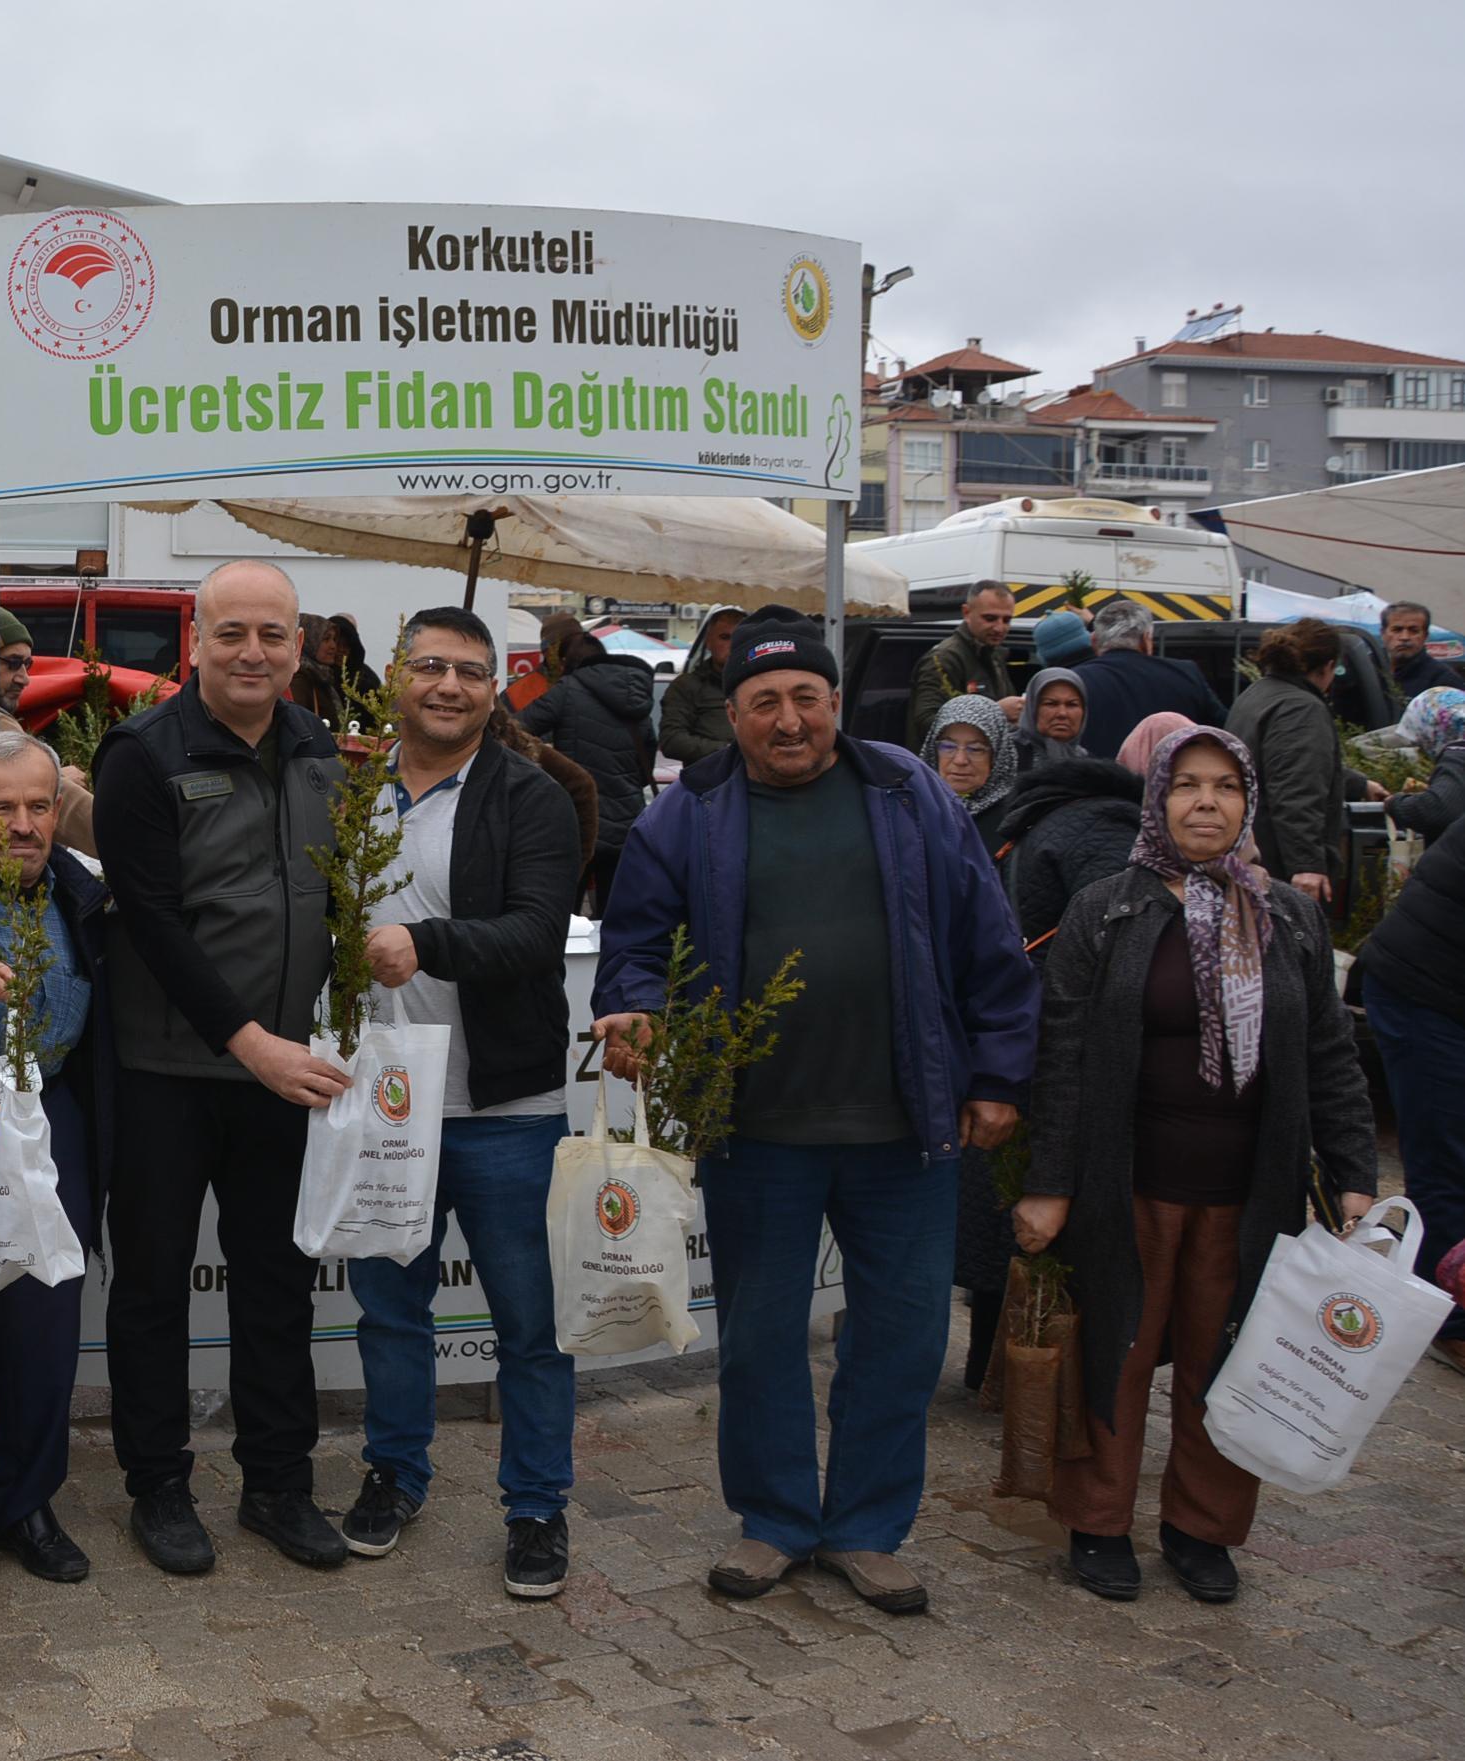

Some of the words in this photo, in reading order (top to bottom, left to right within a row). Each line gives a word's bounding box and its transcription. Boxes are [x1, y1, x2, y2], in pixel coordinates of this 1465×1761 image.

[408, 225, 594, 275] Korkuteli
[210, 297, 361, 345] Orman
[379, 296, 537, 348] işletme
[552, 300, 739, 354] Müdürlüğü
[90, 364, 324, 435] Ücretsiz
[345, 371, 493, 429] Fidan
[513, 371, 689, 436] Dağıtım
[704, 378, 808, 438] Standı
[698, 451, 751, 466] köklerinde
[753, 454, 785, 470] hayat
[397, 470, 613, 494] www.ogm.gov.tr
[581, 1260, 603, 1272] GENEL
[604, 1263, 664, 1275] MÜDÜRLÜĞÜ
[601, 1251, 632, 1262] ORMAN
[1275, 1336, 1305, 1360] GENEL
[1310, 1345, 1347, 1374] ORMAN
